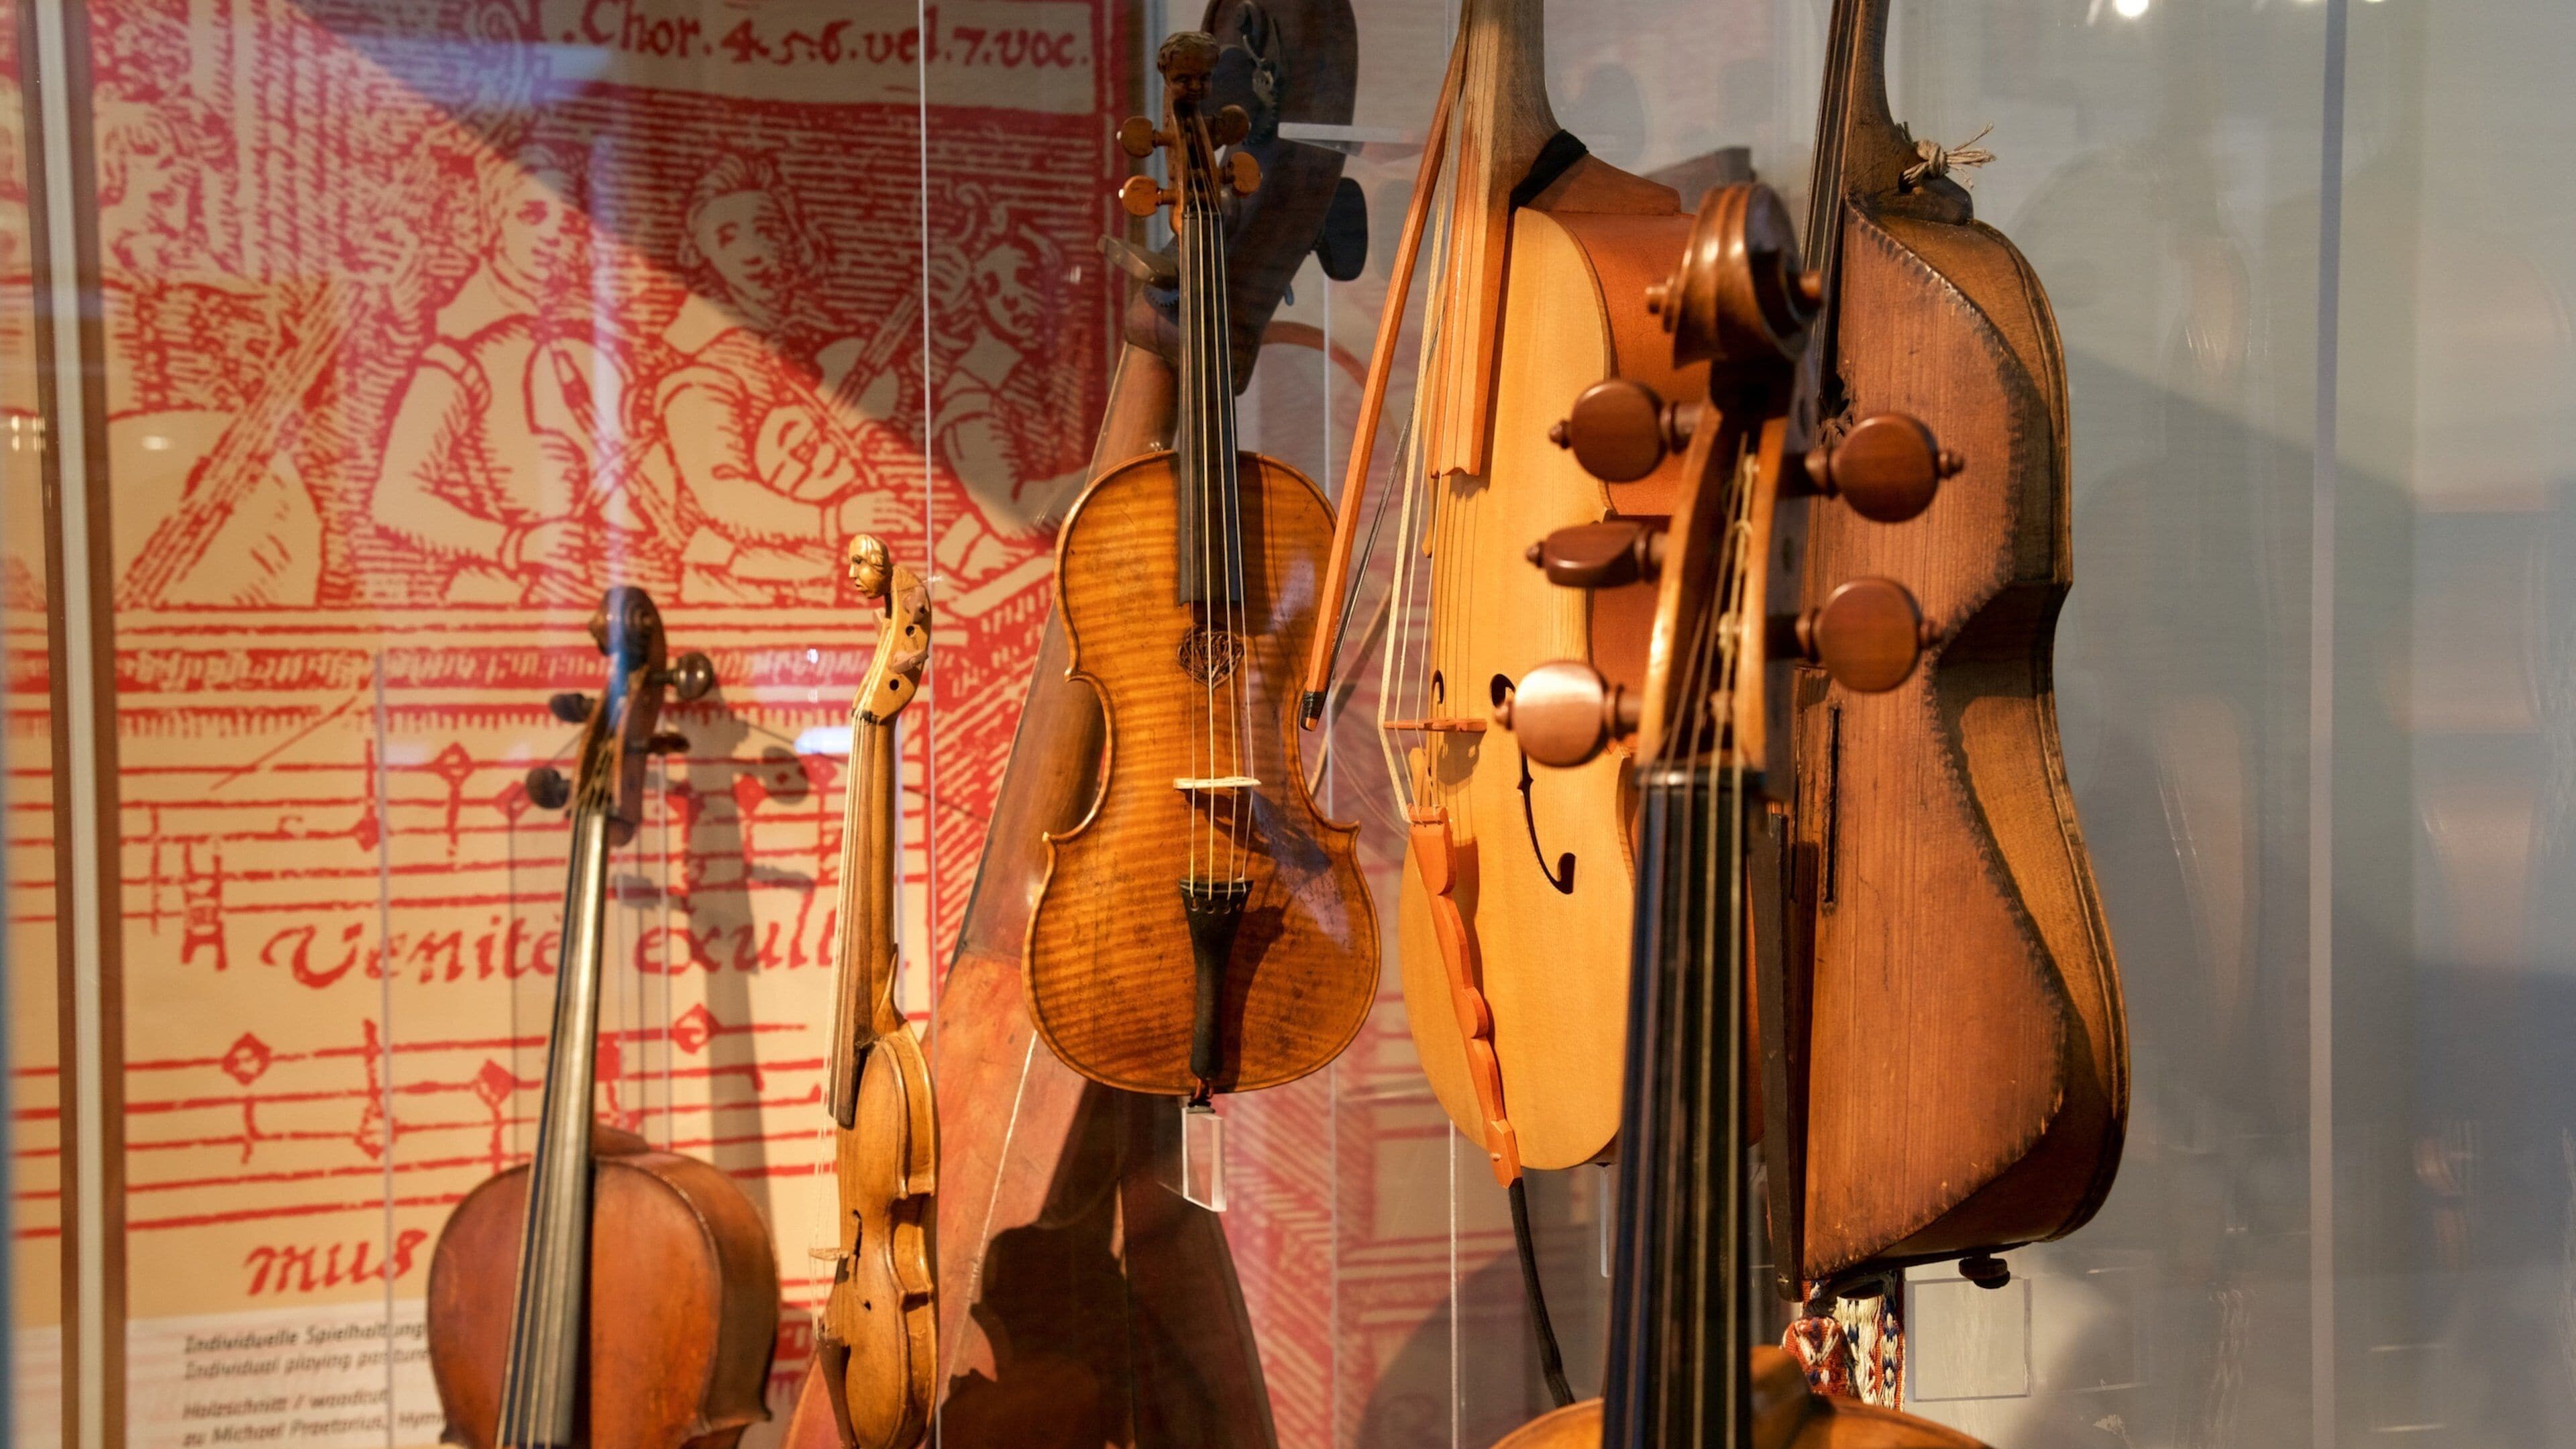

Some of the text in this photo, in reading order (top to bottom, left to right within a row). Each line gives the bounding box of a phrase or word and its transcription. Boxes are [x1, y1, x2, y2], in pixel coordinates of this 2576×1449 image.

[183, 1330, 298, 1354] Individuelle
[183, 1356, 281, 1381] Individual
[284, 1351, 352, 1374] playing
[211, 1421, 286, 1442] Michael
